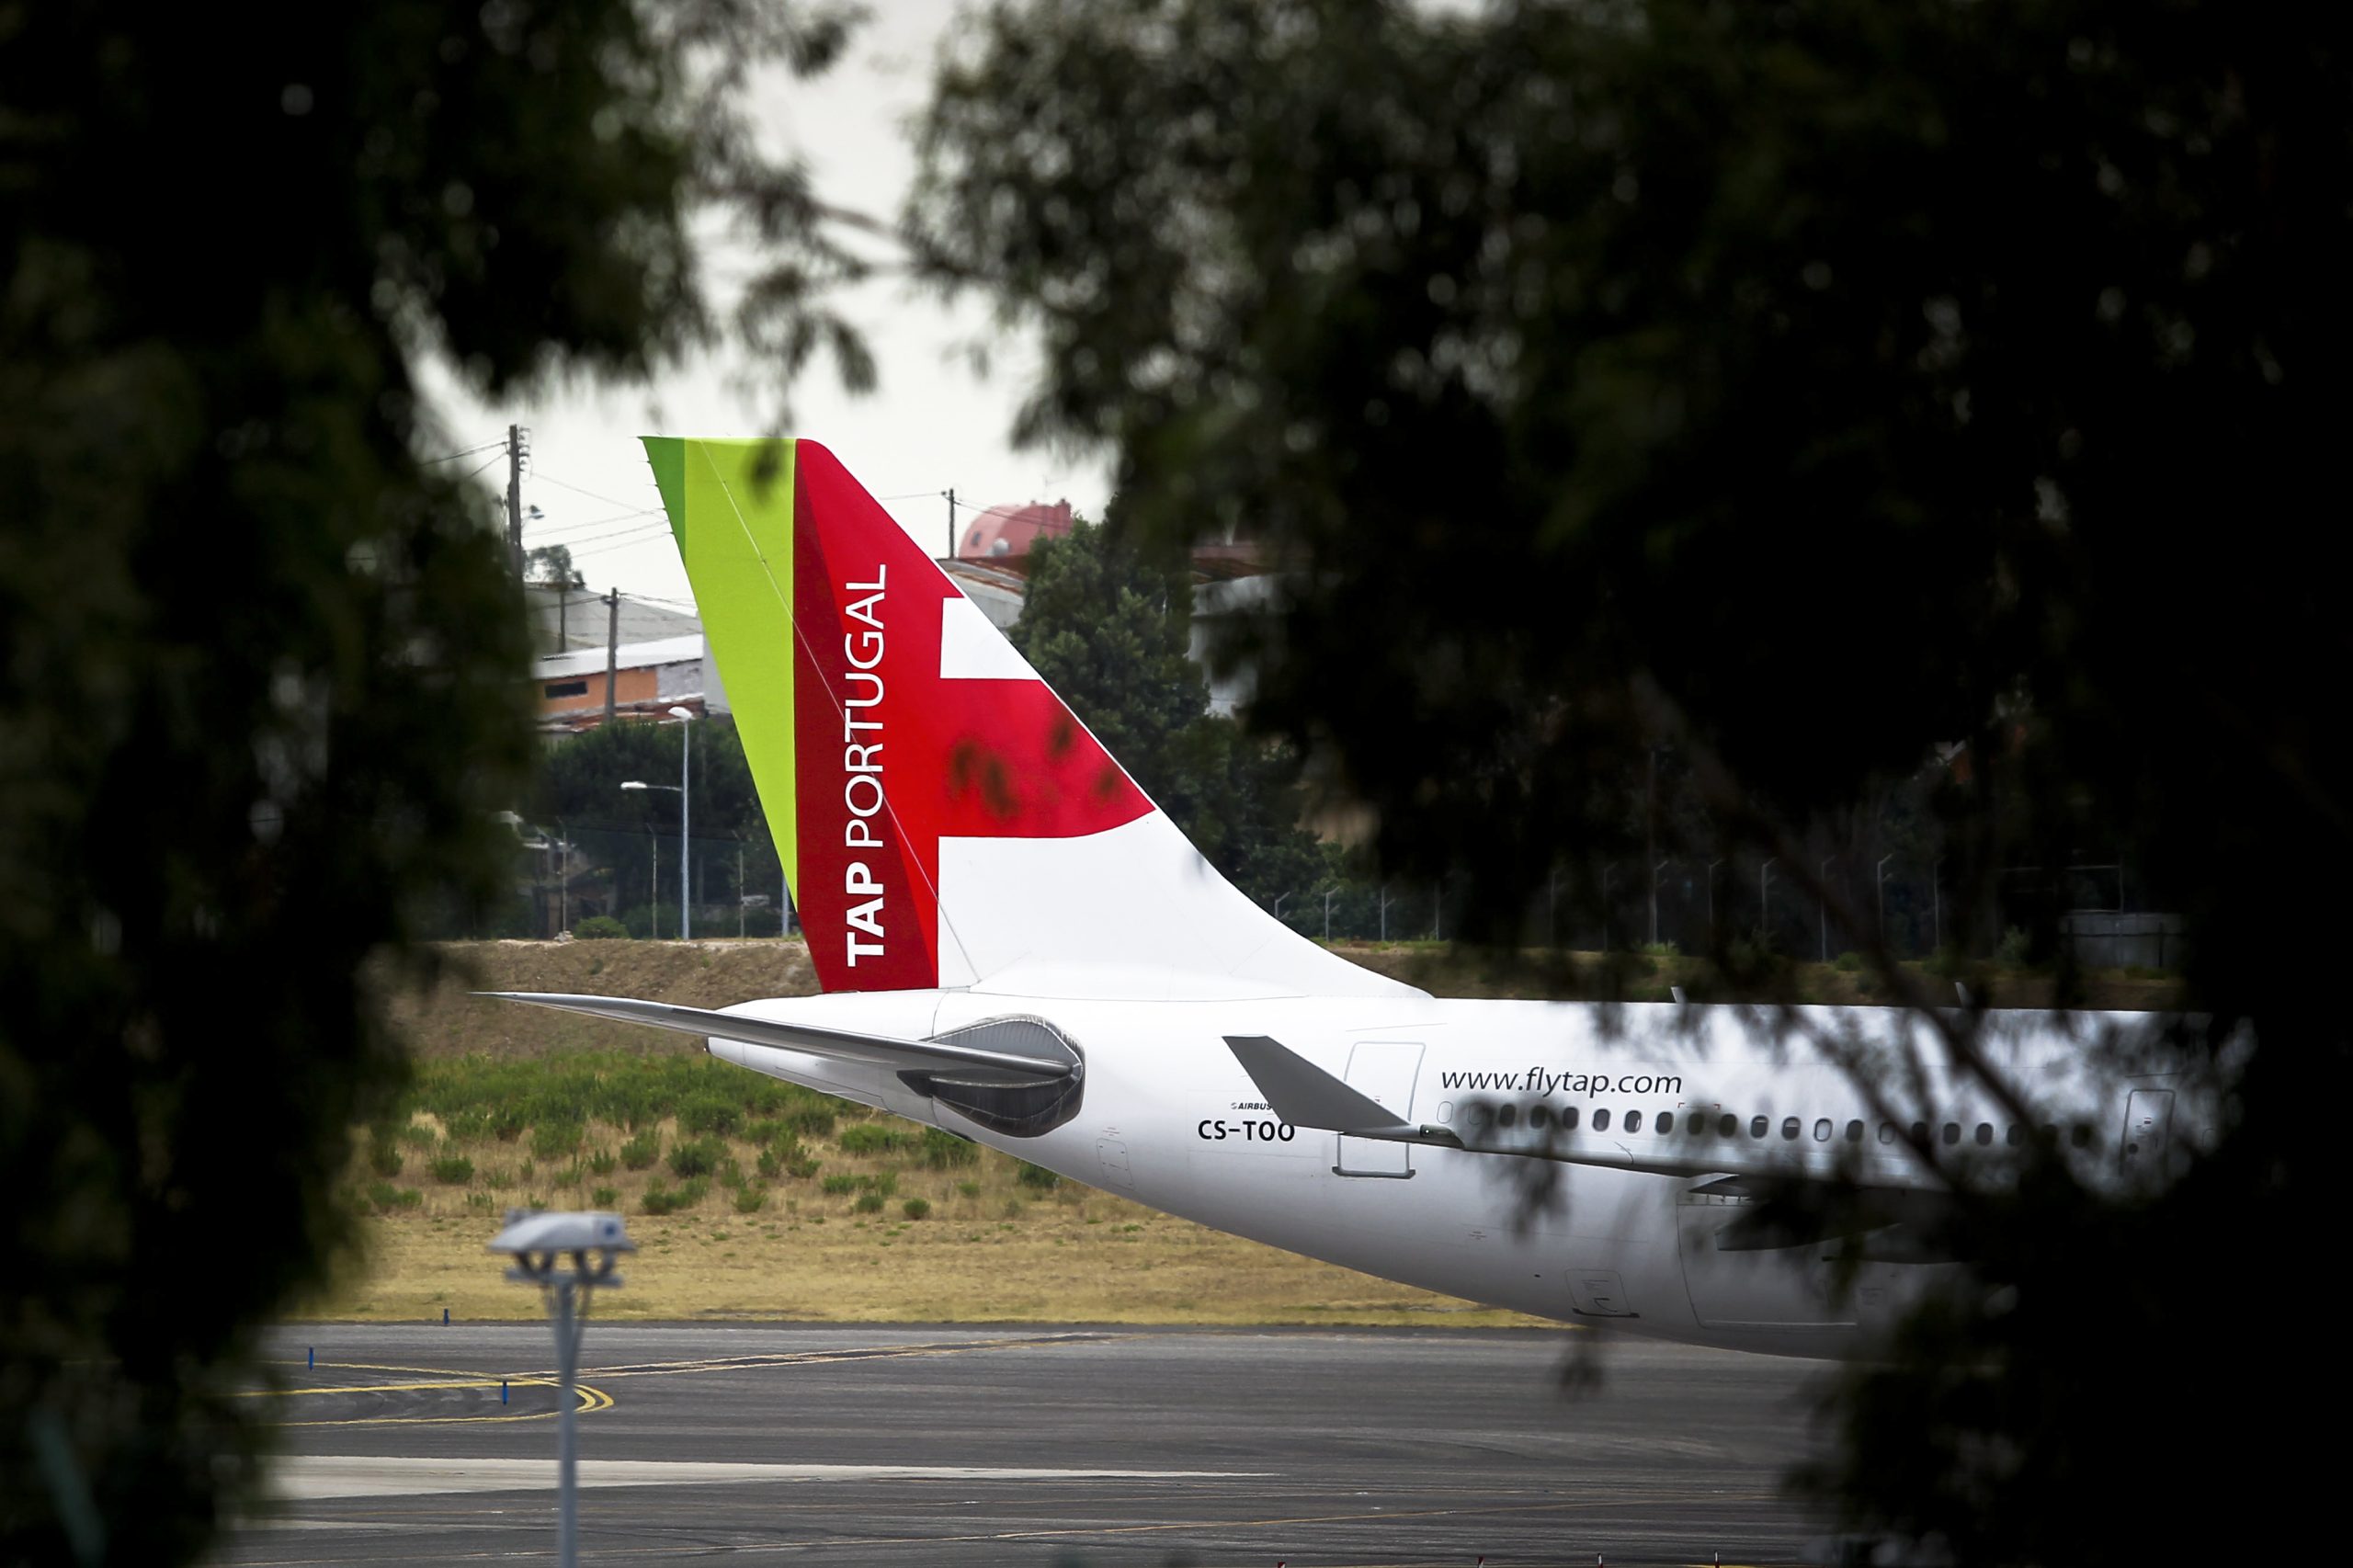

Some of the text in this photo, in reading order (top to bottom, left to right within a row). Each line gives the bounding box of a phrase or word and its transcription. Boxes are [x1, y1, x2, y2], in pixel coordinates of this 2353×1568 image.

[844, 563, 886, 967] TAP PORTUGAL
[1441, 1066, 1683, 1099] www.flytap.com
[1198, 1119, 1295, 1142] CS-TOO
